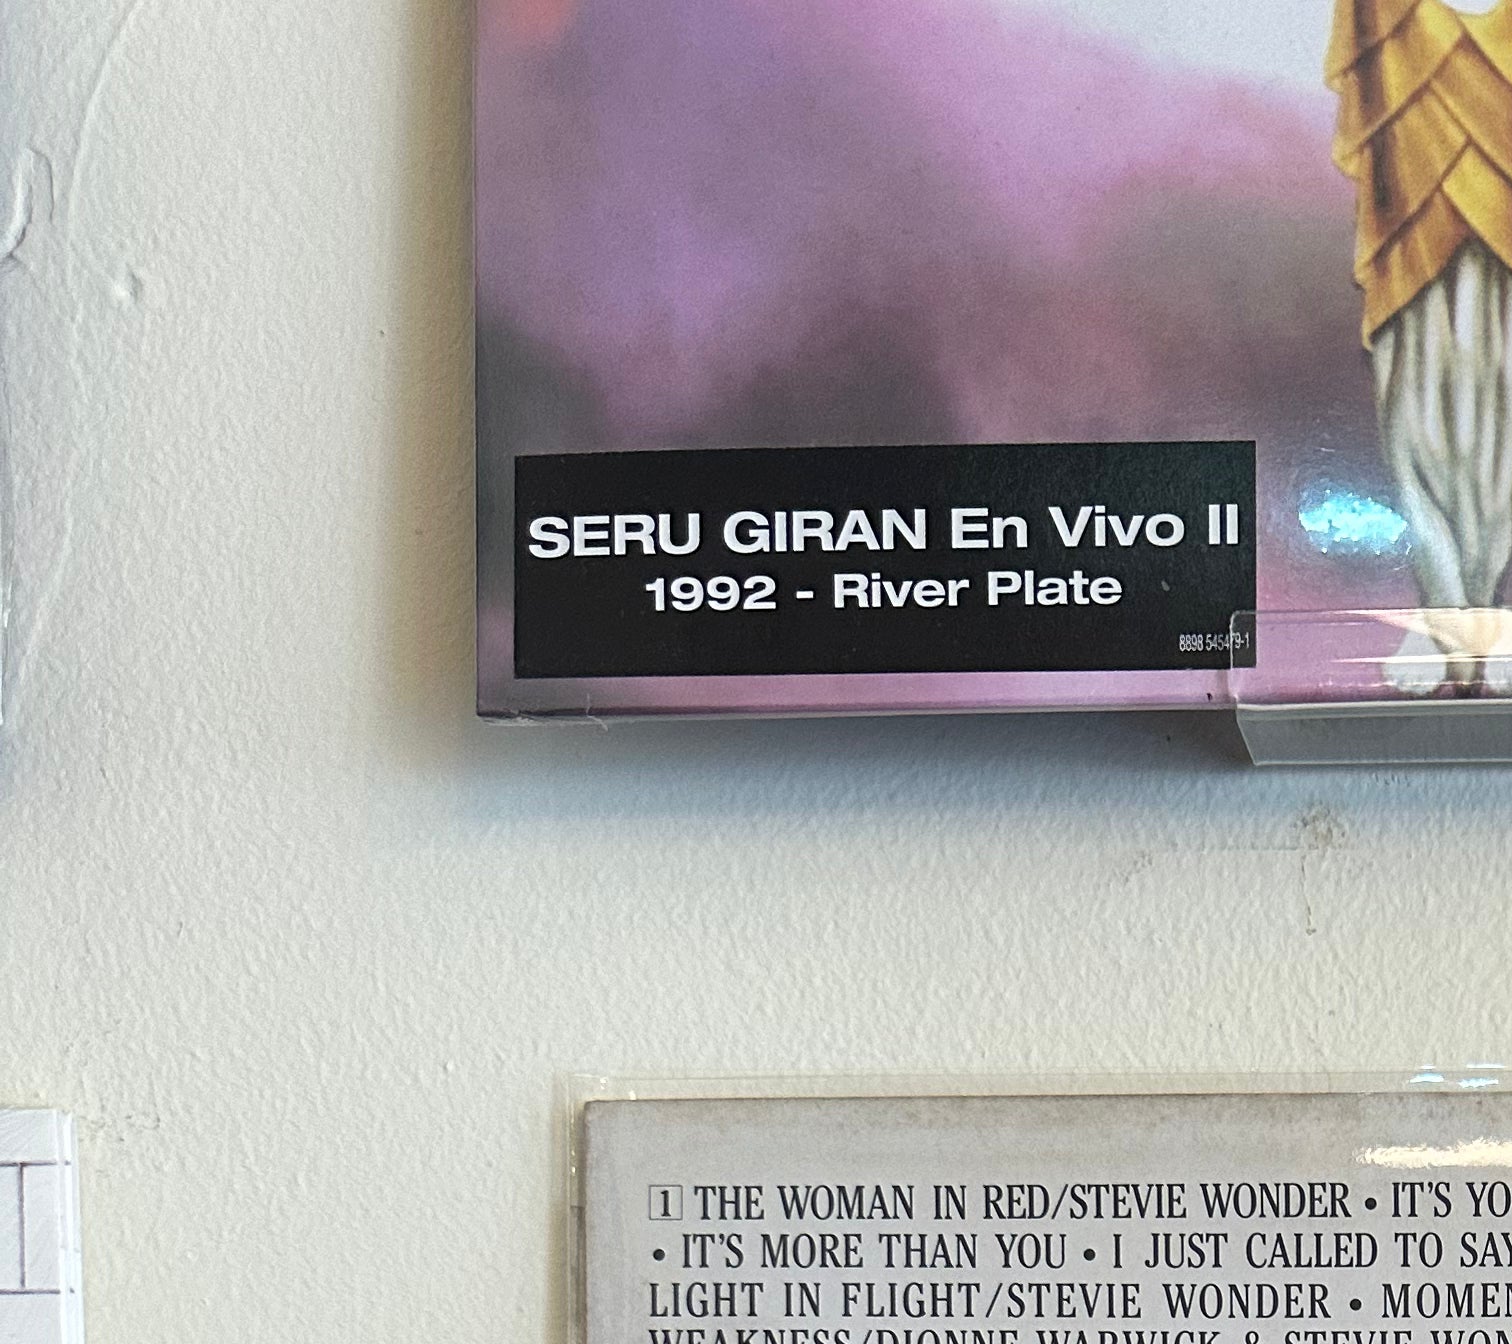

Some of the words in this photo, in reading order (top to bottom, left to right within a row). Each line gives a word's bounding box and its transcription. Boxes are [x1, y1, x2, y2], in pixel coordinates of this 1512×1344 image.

[529, 513, 700, 558] SERU
[723, 509, 926, 553] GIRAN
[951, 508, 1027, 548] En
[1048, 505, 1184, 546] Vivo
[1209, 504, 1238, 544] II
[646, 576, 776, 611] 1992
[834, 573, 969, 608] River
[988, 570, 1122, 605] Plate
[694, 1186, 764, 1220] THE
[777, 1185, 914, 1220] WOMAN
[933, 1185, 966, 1220] IN
[983, 1183, 1186, 1219] RED/STEVIE
[1199, 1182, 1352, 1218] WONDER
[1392, 1181, 1451, 1217] IT'S
[682, 1233, 743, 1268] IT'S
[761, 1233, 863, 1268] MORE
[879, 1233, 977, 1268] THAN
[995, 1233, 1066, 1269] YOU
[1113, 1234, 1122, 1268] I
[1145, 1233, 1228, 1268] JUST
[1246, 1233, 1377, 1268] CALLED
[1395, 1232, 1442, 1268] TO
[649, 1282, 763, 1317] LIGHT
[784, 1283, 820, 1317] IN
[842, 1282, 1141, 1318] FLIGHT/STEVIE
[1162, 1284, 1331, 1319] WONDER
